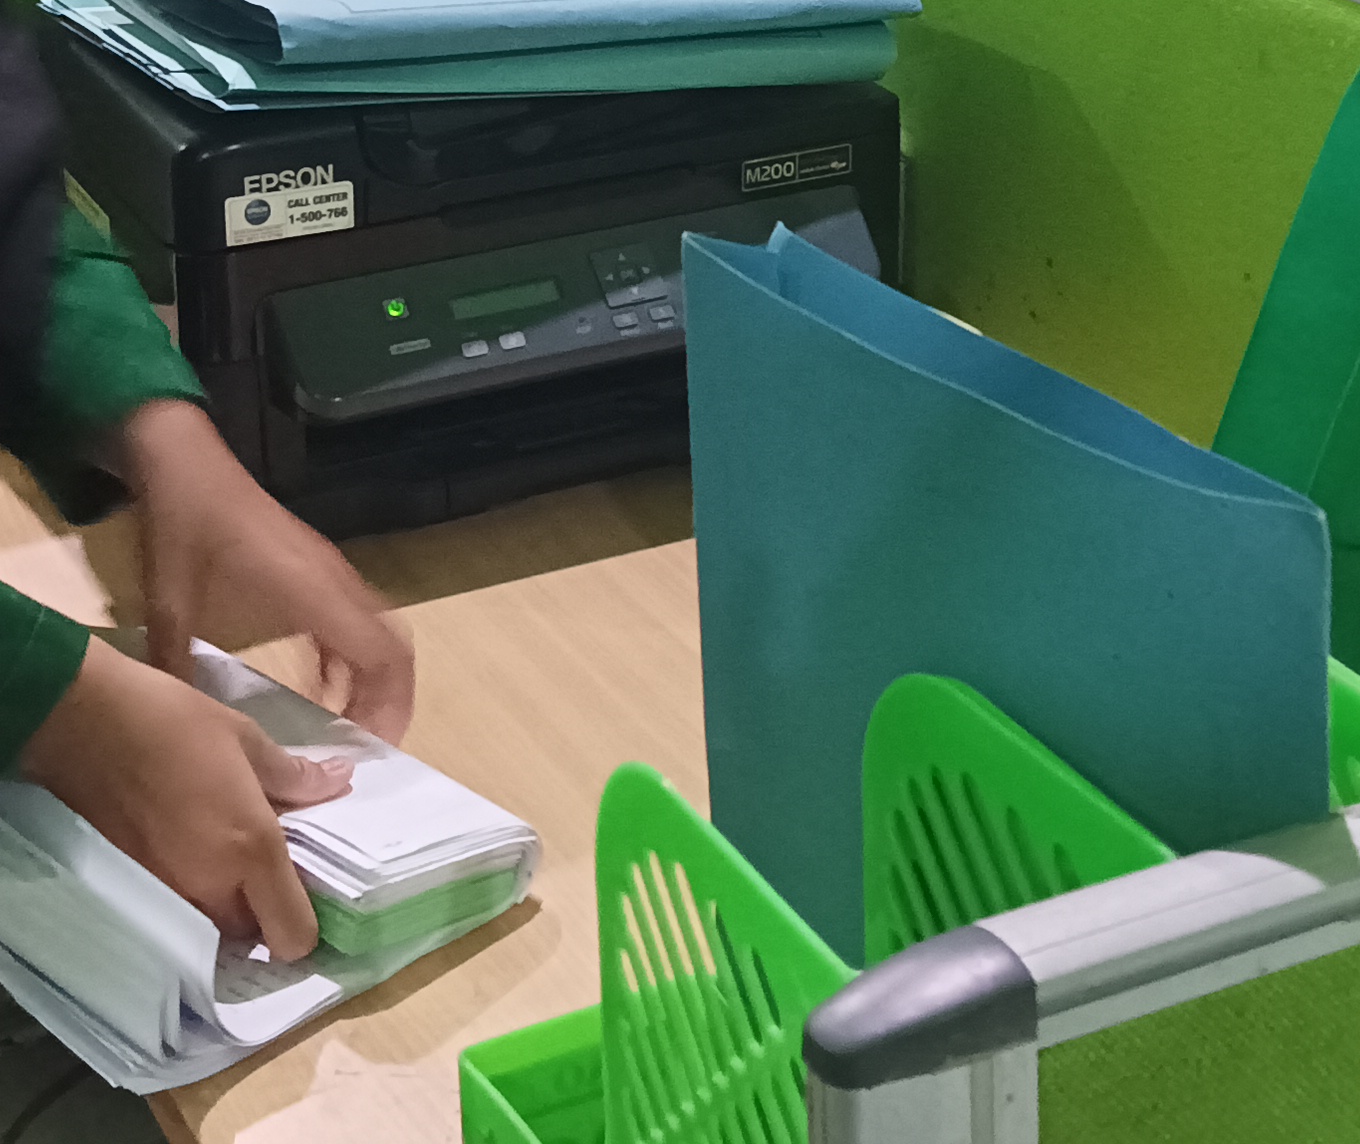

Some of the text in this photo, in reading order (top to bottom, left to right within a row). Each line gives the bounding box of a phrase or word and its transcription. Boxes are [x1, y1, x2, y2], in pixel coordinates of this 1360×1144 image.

[244, 163, 334, 196] EPSON
[745, 161, 795, 184] M200
[287, 191, 348, 209] CALL CENTER
